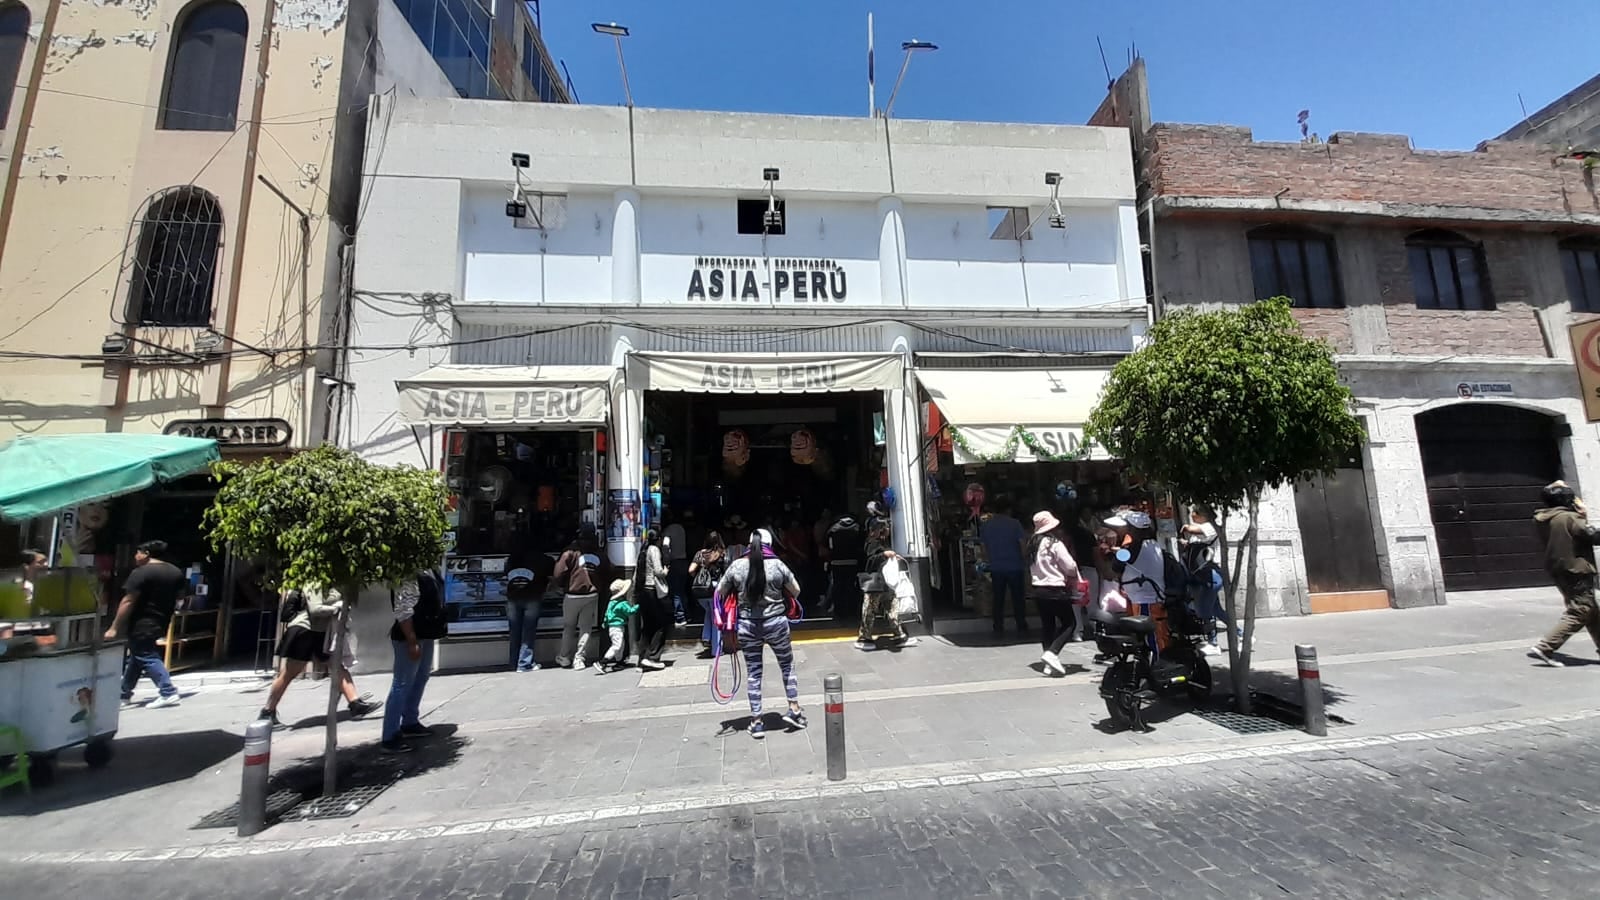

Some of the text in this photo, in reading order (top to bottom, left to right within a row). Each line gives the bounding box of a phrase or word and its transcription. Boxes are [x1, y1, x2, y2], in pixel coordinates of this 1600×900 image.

[694, 257, 757, 269] IMPORTADORA
[774, 258, 837, 270] EXPORTADORA
[700, 364, 756, 387] ASIA
[776, 363, 838, 387] PERU
[424, 390, 488, 417] ASIA
[513, 390, 583, 417] PERU
